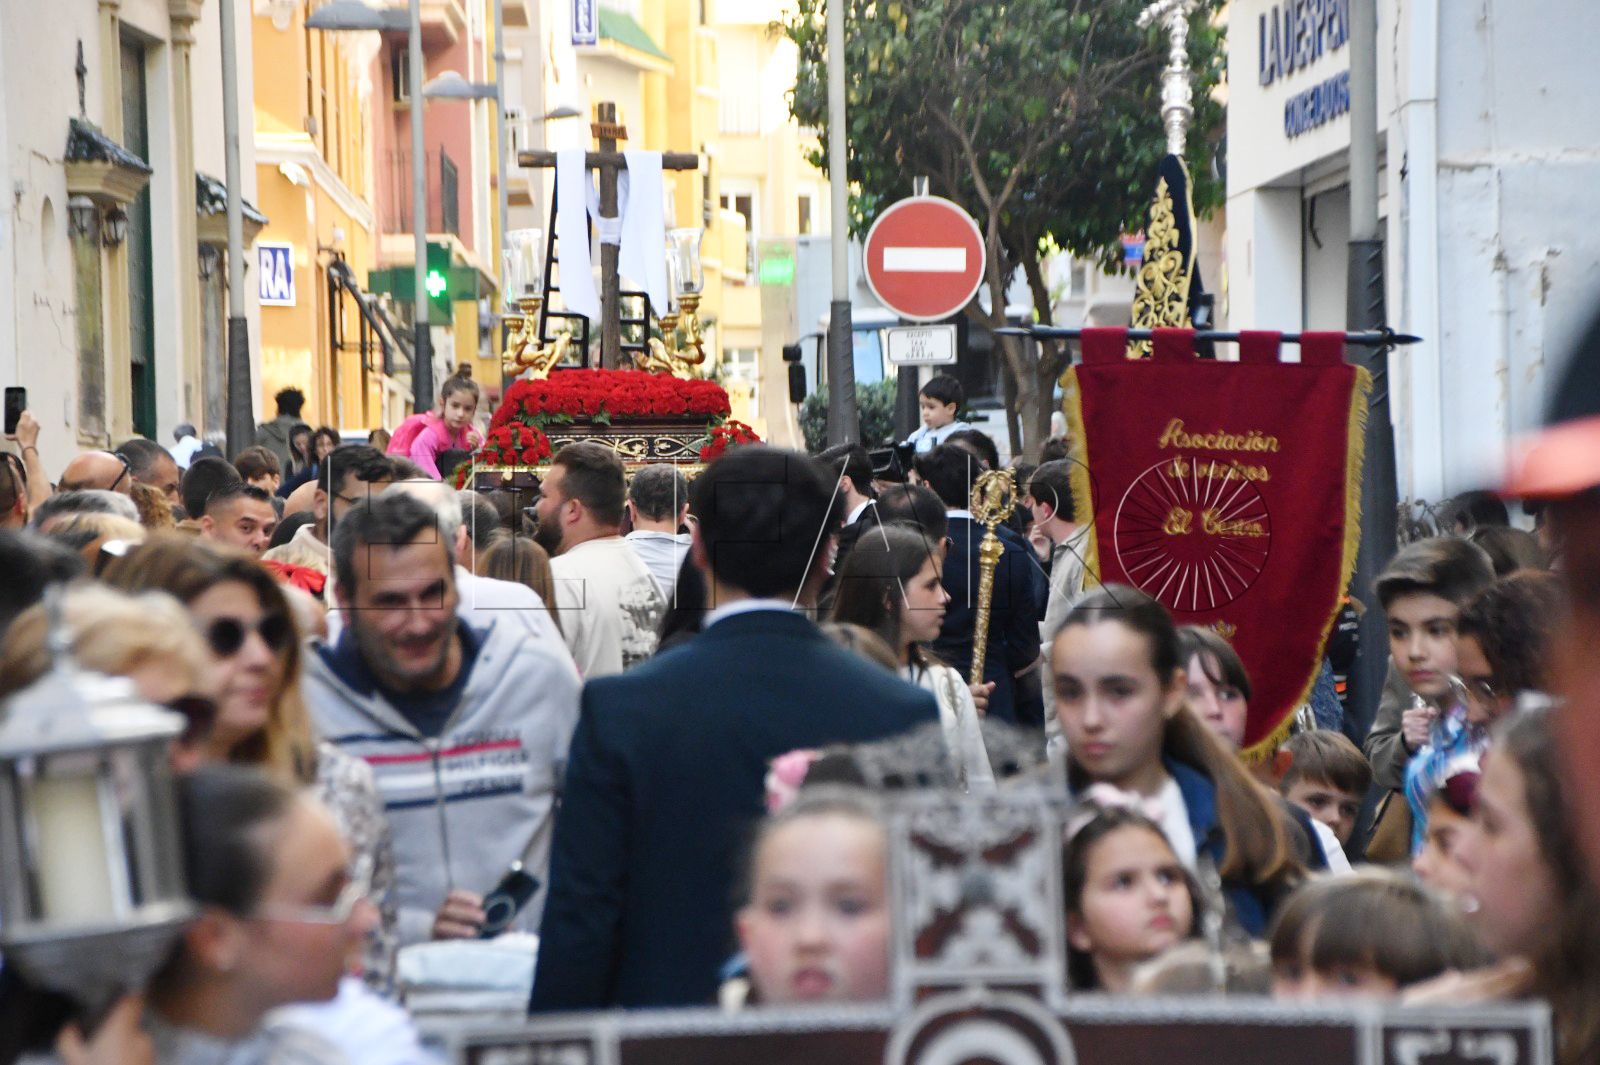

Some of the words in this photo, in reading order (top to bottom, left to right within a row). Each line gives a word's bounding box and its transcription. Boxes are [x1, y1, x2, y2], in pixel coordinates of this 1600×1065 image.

[1159, 418, 1280, 452] Asociación
[1167, 455, 1190, 477] de
[1198, 460, 1270, 481] vecinos
